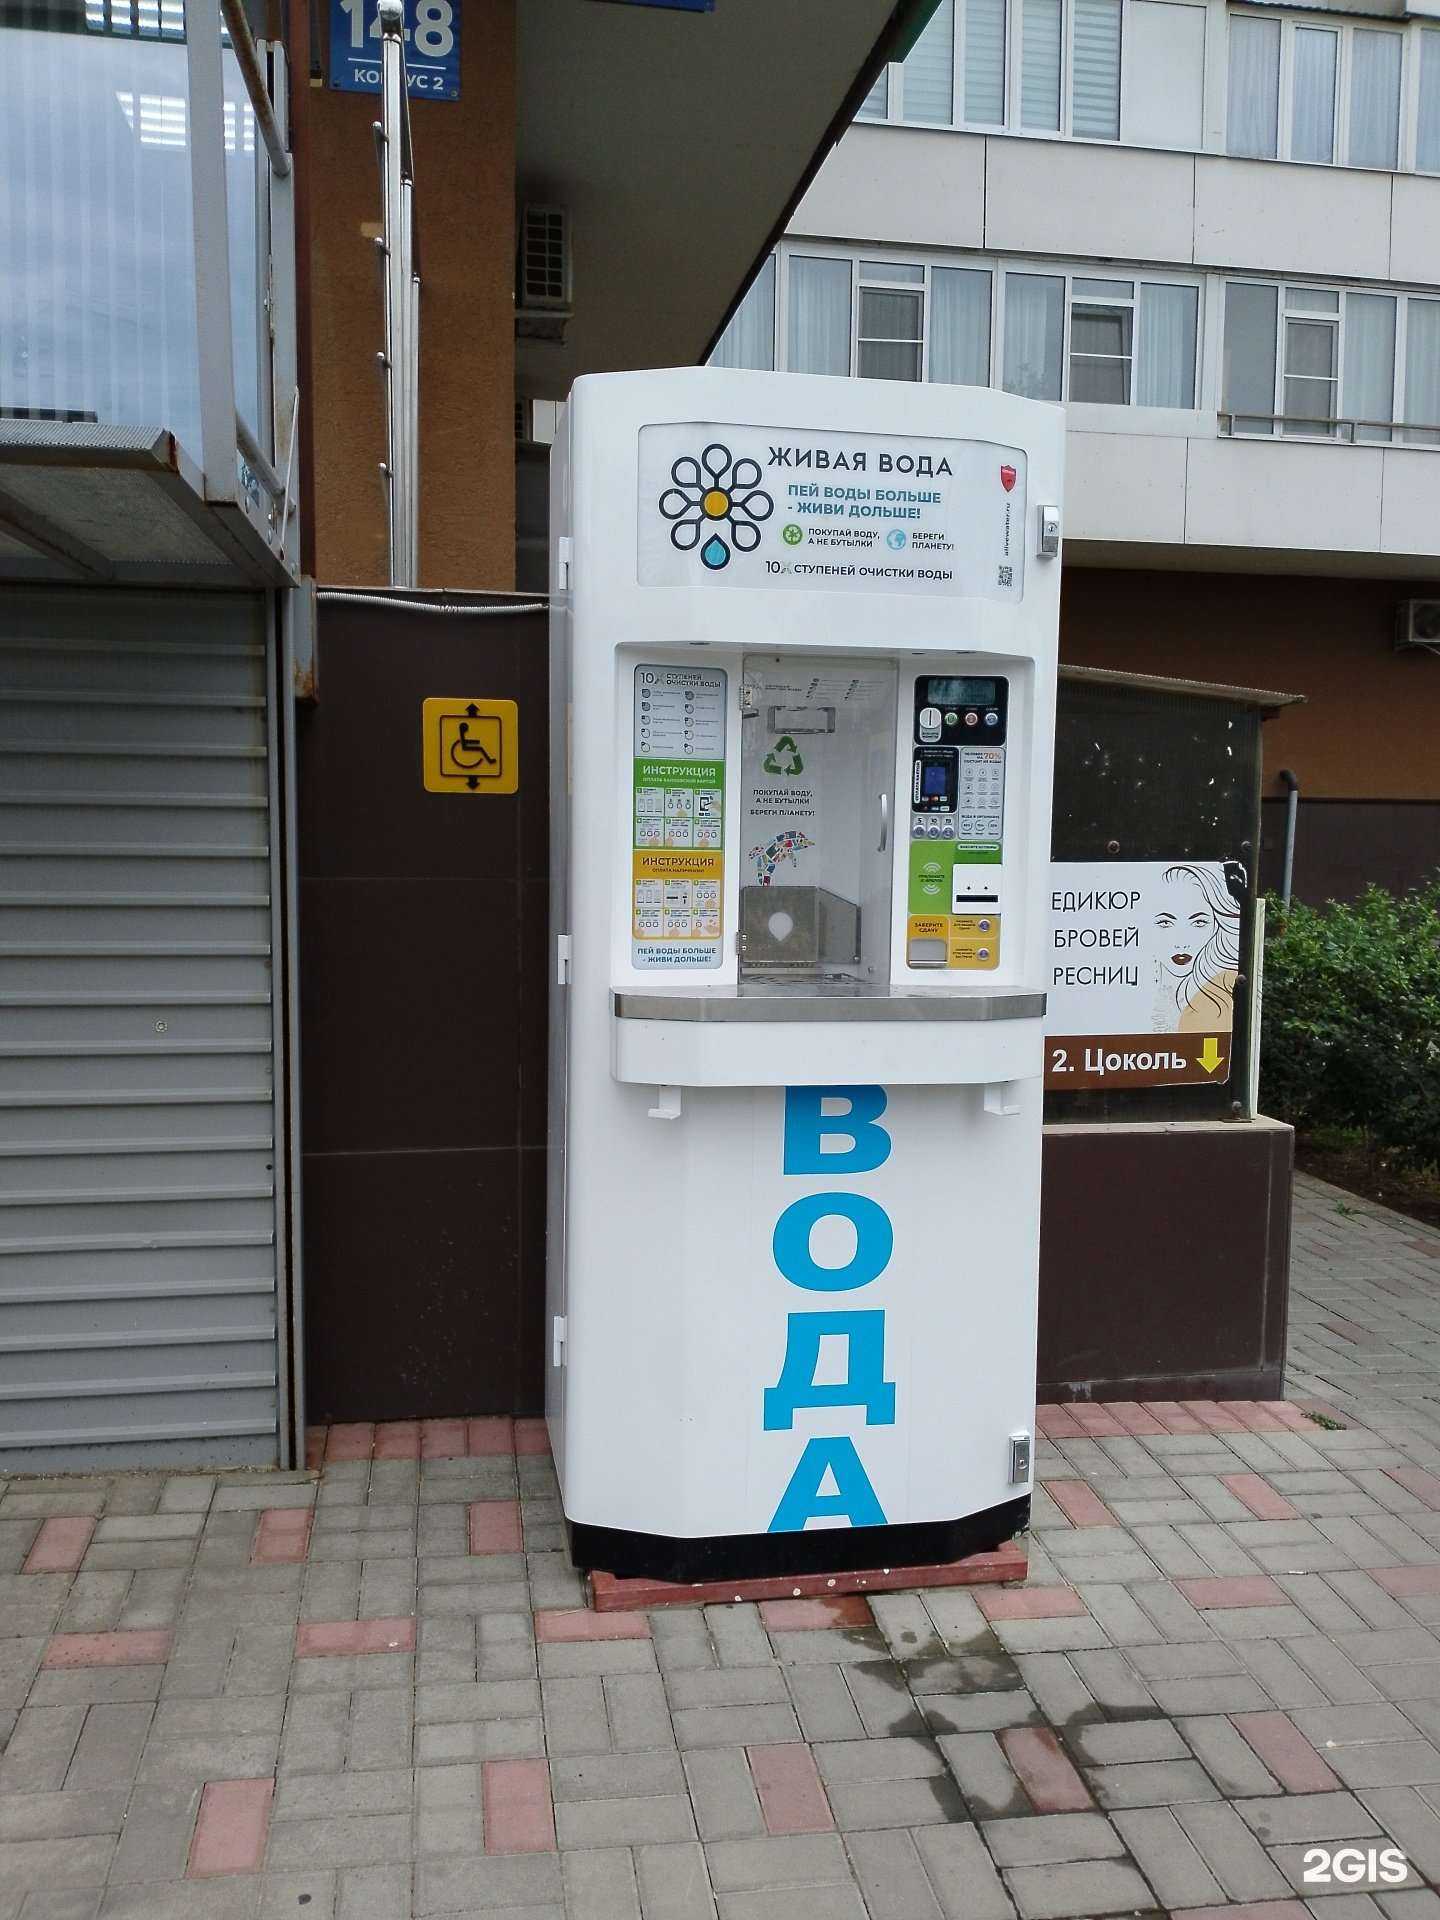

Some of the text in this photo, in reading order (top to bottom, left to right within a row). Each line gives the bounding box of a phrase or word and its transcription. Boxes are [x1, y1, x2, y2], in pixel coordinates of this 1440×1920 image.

[354, 68, 444, 90] КОУС 2
[768, 446, 953, 478] ЖИВАЯ ВОДА
[788, 483, 941, 504] ПЕЙ ВОДЫ БОЛЬШЕ
[797, 501, 844, 515] ЖИВИ
[848, 505, 921, 519] ДОЛЬШЕ!
[808, 527, 880, 539] ПОКУПАЙ ВОДУ,
[912, 532, 945, 541] БЕРЕГИ
[830, 539, 873, 548] БУТЫЛКИ
[912, 542, 954, 551] ПЛАНЕТУ!
[794, 563, 856, 576] СТУПЕНЕЙ
[859, 567, 914, 578] ОЧИСТКИ
[917, 569, 953, 580] ВОДЫ
[643, 766, 716, 777] ИНСТРУКЦИЯ
[642, 857, 714, 867] ИНСТРУКЦИЯ
[1054, 926, 1139, 948] БРОВЕЙ
[637, 947, 654, 955] ПЕЙ
[682, 947, 717, 955] БОЛЬШЕ
[1053, 966, 1138, 986] РЕСНИЦ
[1052, 1048, 1187, 1076] 2. Цоколь
[764, 1084, 896, 1533] ВОДА
